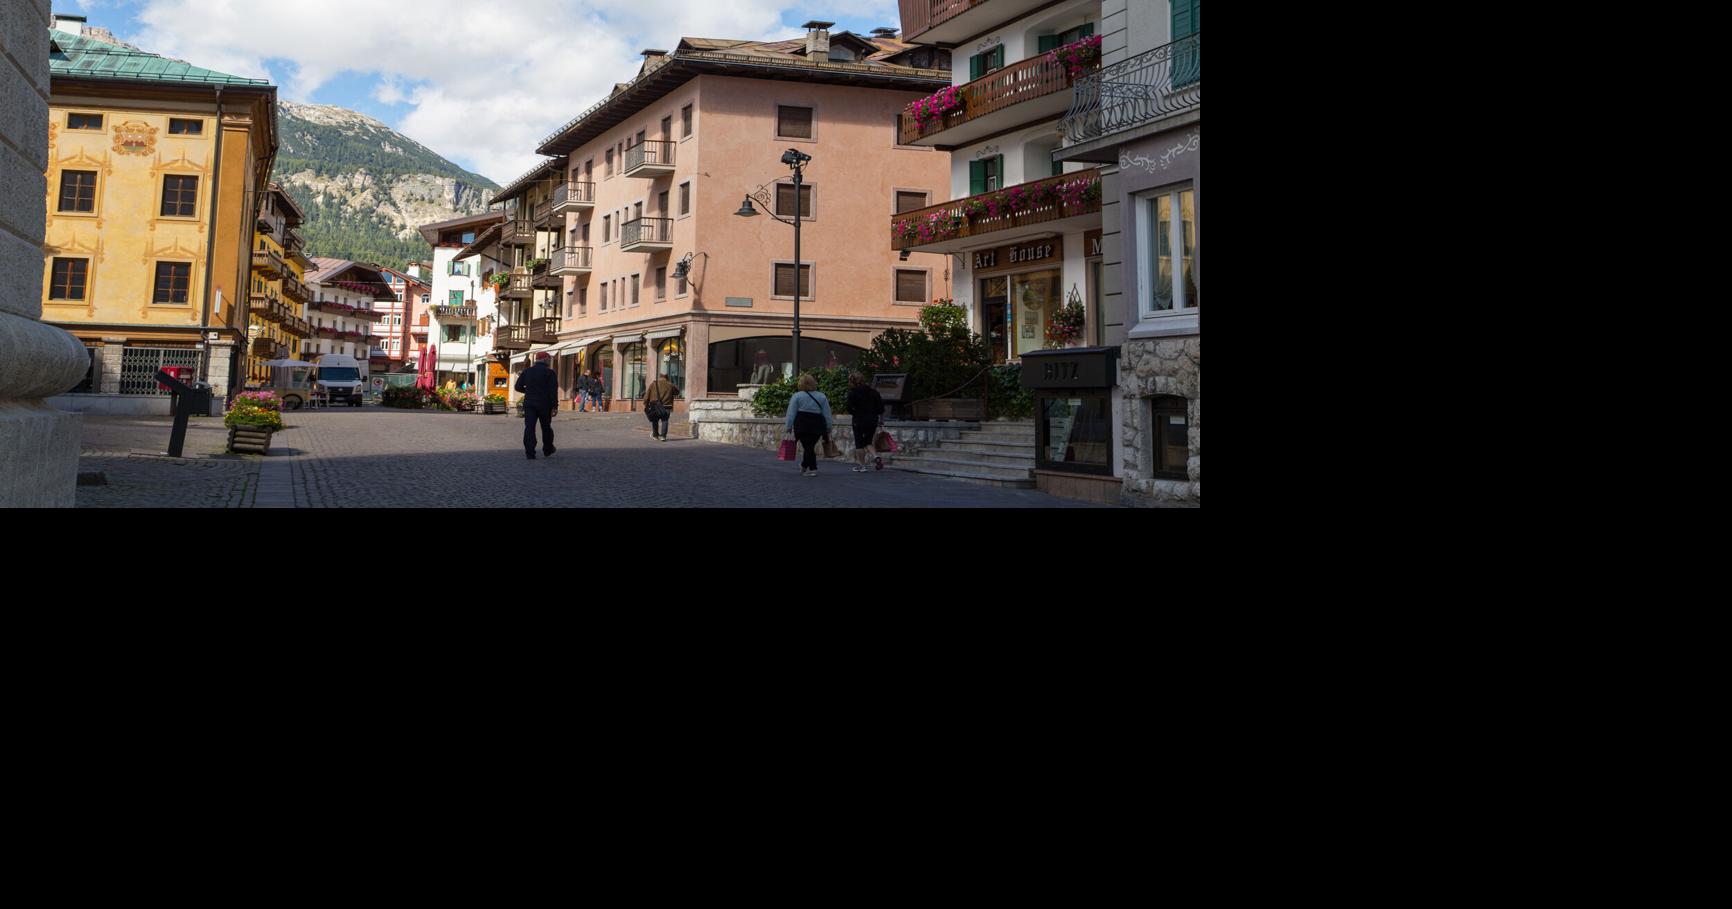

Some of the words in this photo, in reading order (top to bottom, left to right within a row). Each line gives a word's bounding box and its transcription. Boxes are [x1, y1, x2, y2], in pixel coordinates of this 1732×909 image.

[974, 250, 996, 269] Art
[1008, 243, 1053, 263] House
[1043, 362, 1079, 380] RITZ
